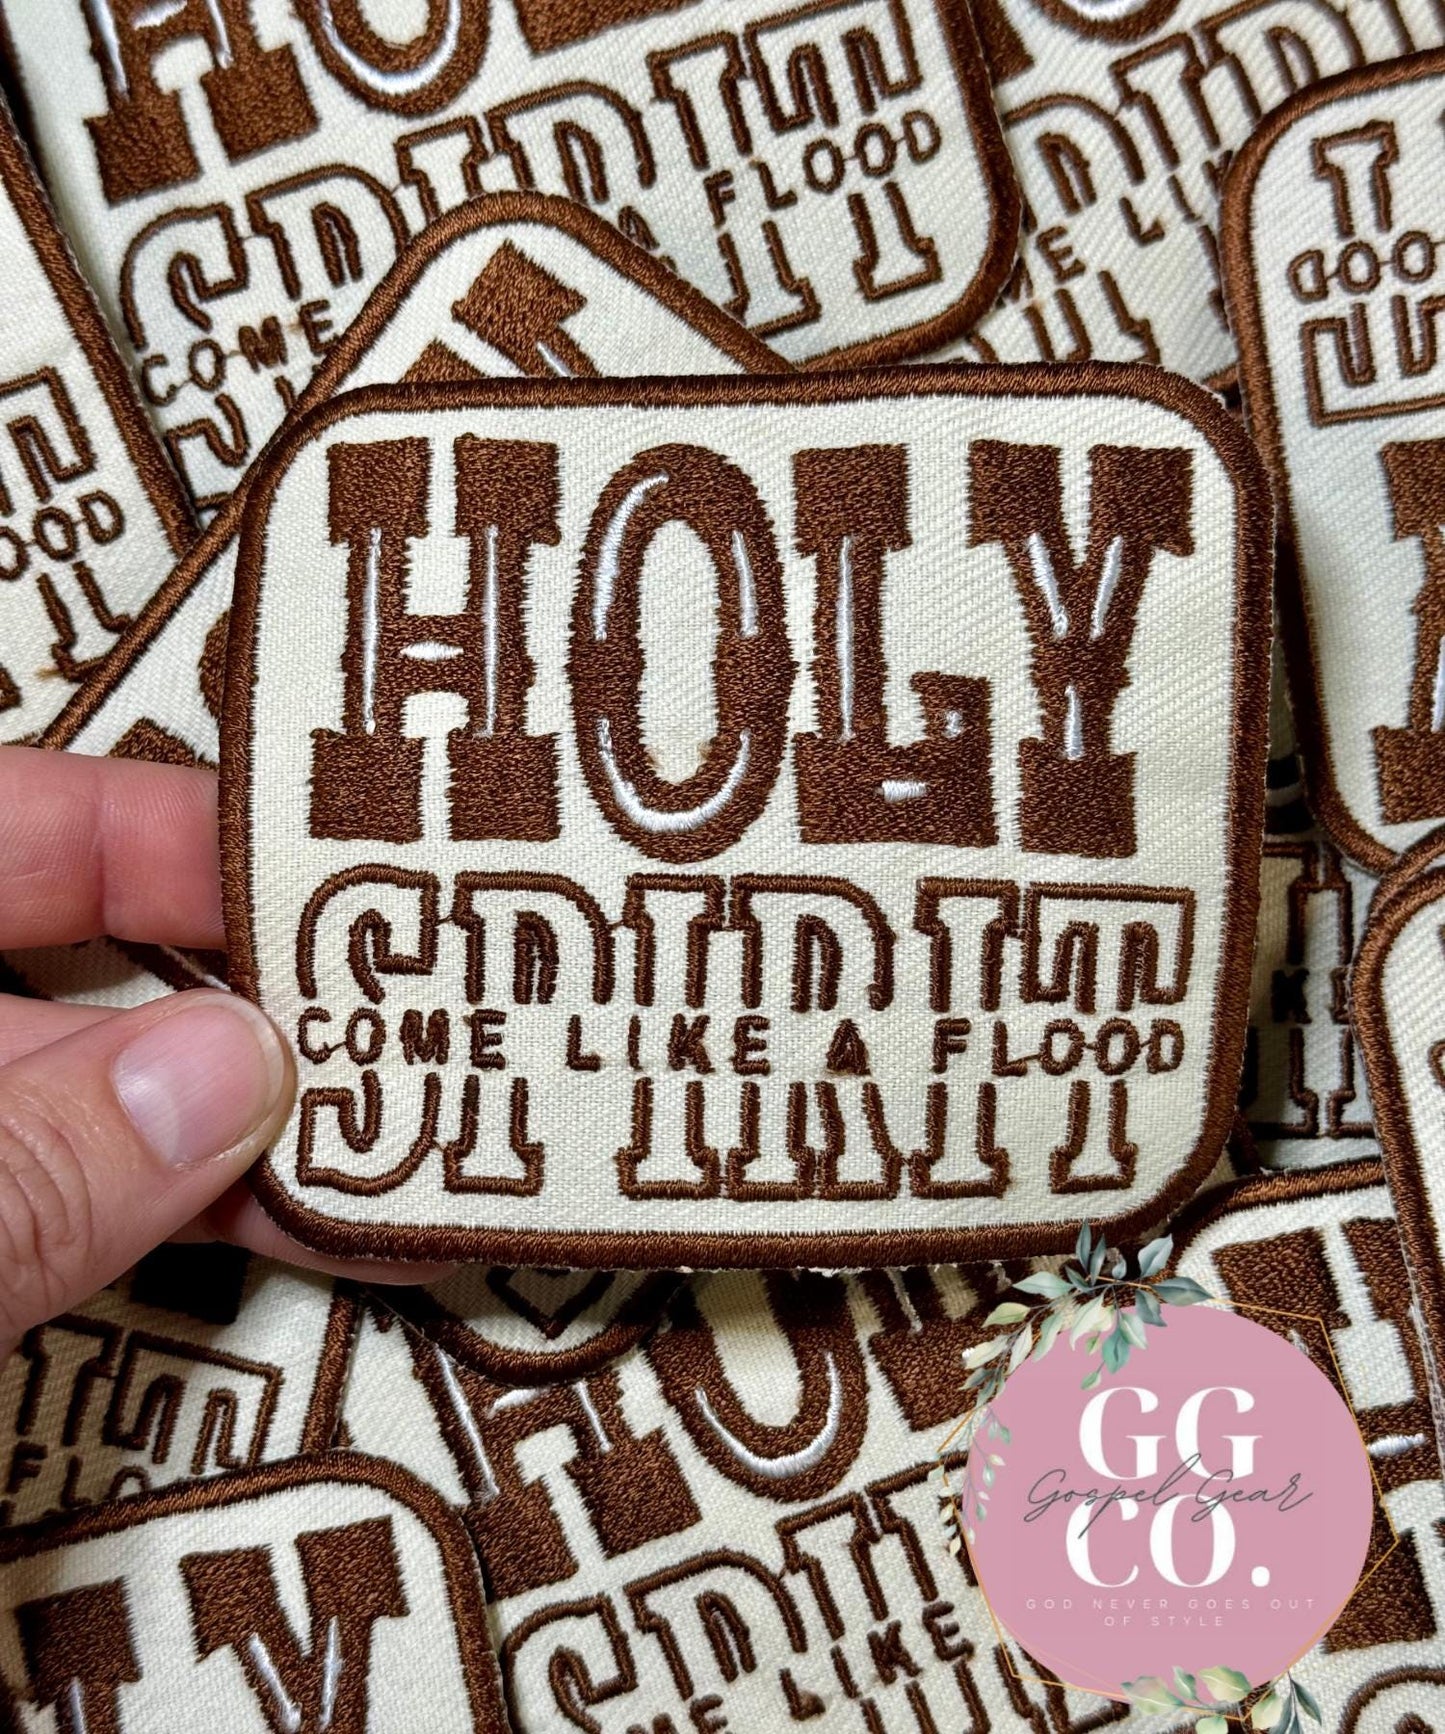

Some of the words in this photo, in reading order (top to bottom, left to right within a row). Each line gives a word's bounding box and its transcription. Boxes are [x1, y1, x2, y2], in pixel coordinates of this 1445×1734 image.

[140, 298, 340, 407] COME
[702, 109, 943, 230] FLOOD
[309, 433, 1195, 862] HOLY
[296, 862, 1196, 1201] SPIRIT
[296, 1005, 507, 1071] COME
[566, 1012, 771, 1075] LIKE
[825, 1016, 871, 1077] A
[933, 1016, 1185, 1077] FLOOD
[779, 1601, 974, 1721] LIKE
